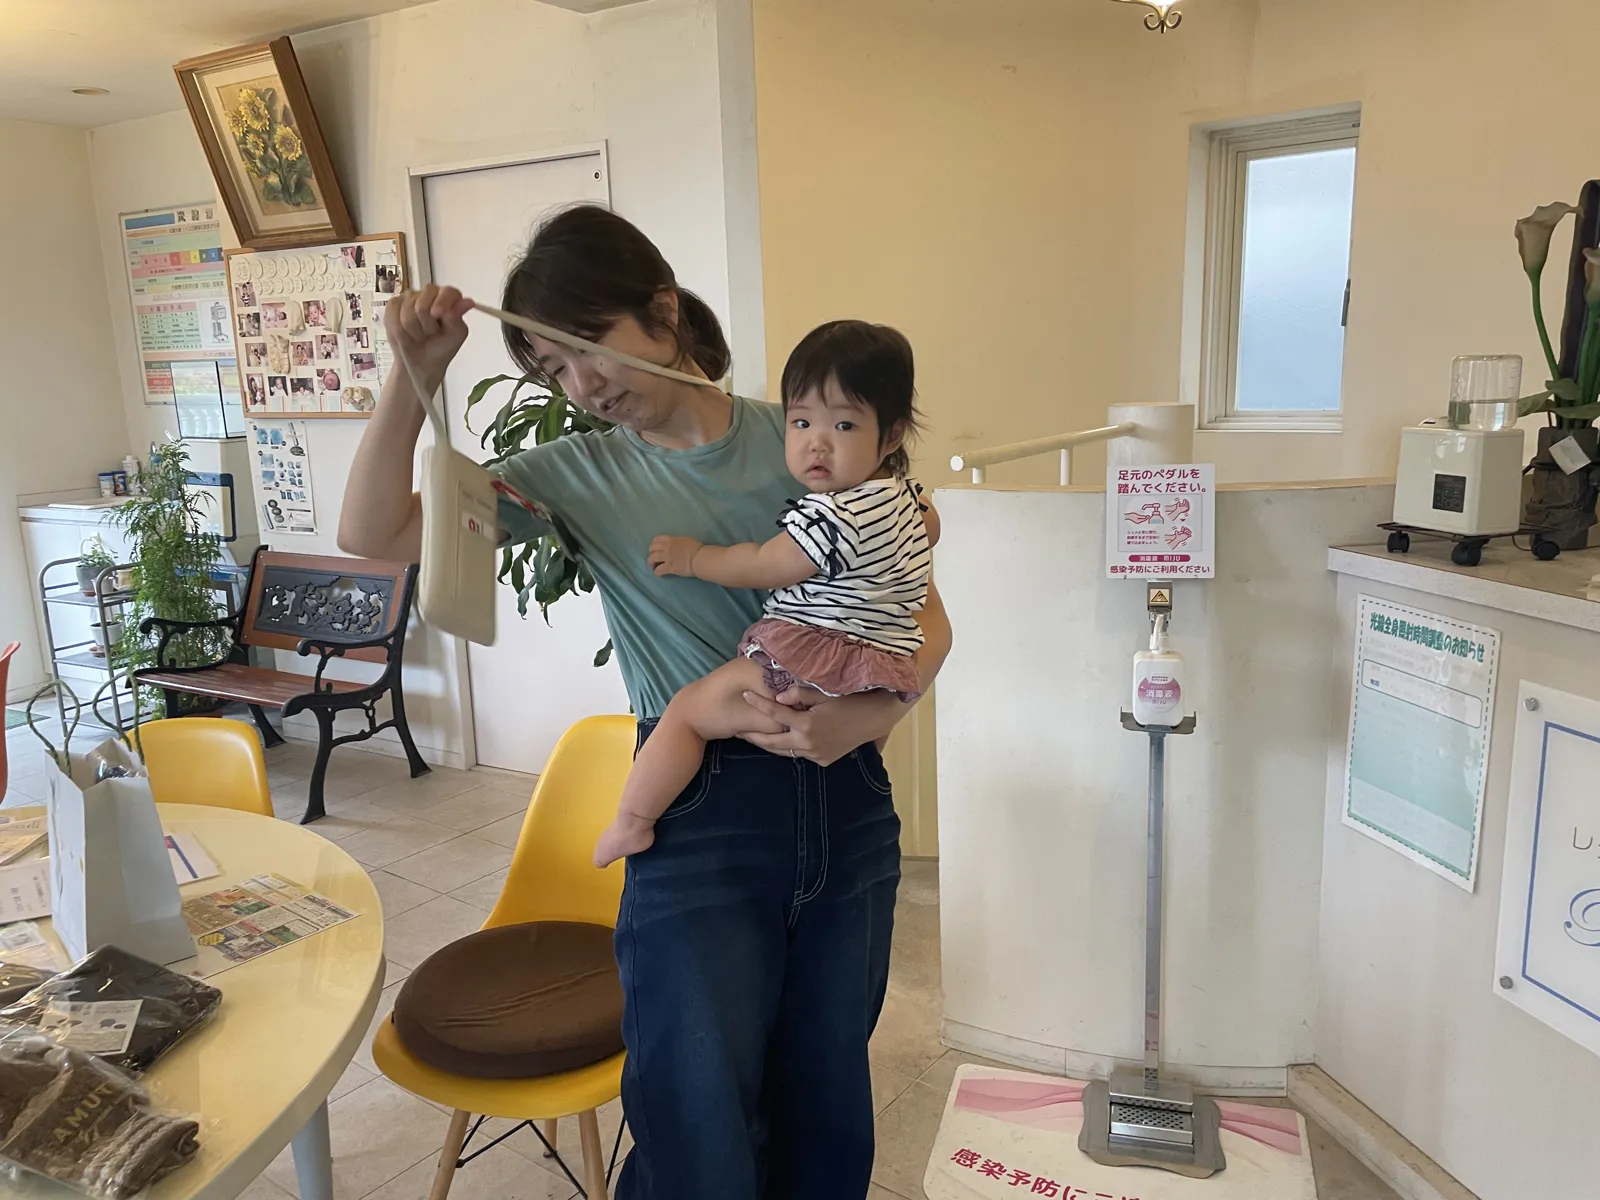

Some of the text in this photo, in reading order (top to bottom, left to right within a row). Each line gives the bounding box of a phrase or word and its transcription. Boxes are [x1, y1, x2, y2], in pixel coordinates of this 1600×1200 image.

[1118, 468, 1200, 481] 足元のペダルを
[1117, 482, 1206, 494] 踏んでください。
[1110, 565, 1210, 574] 感染予防にご利用ください
